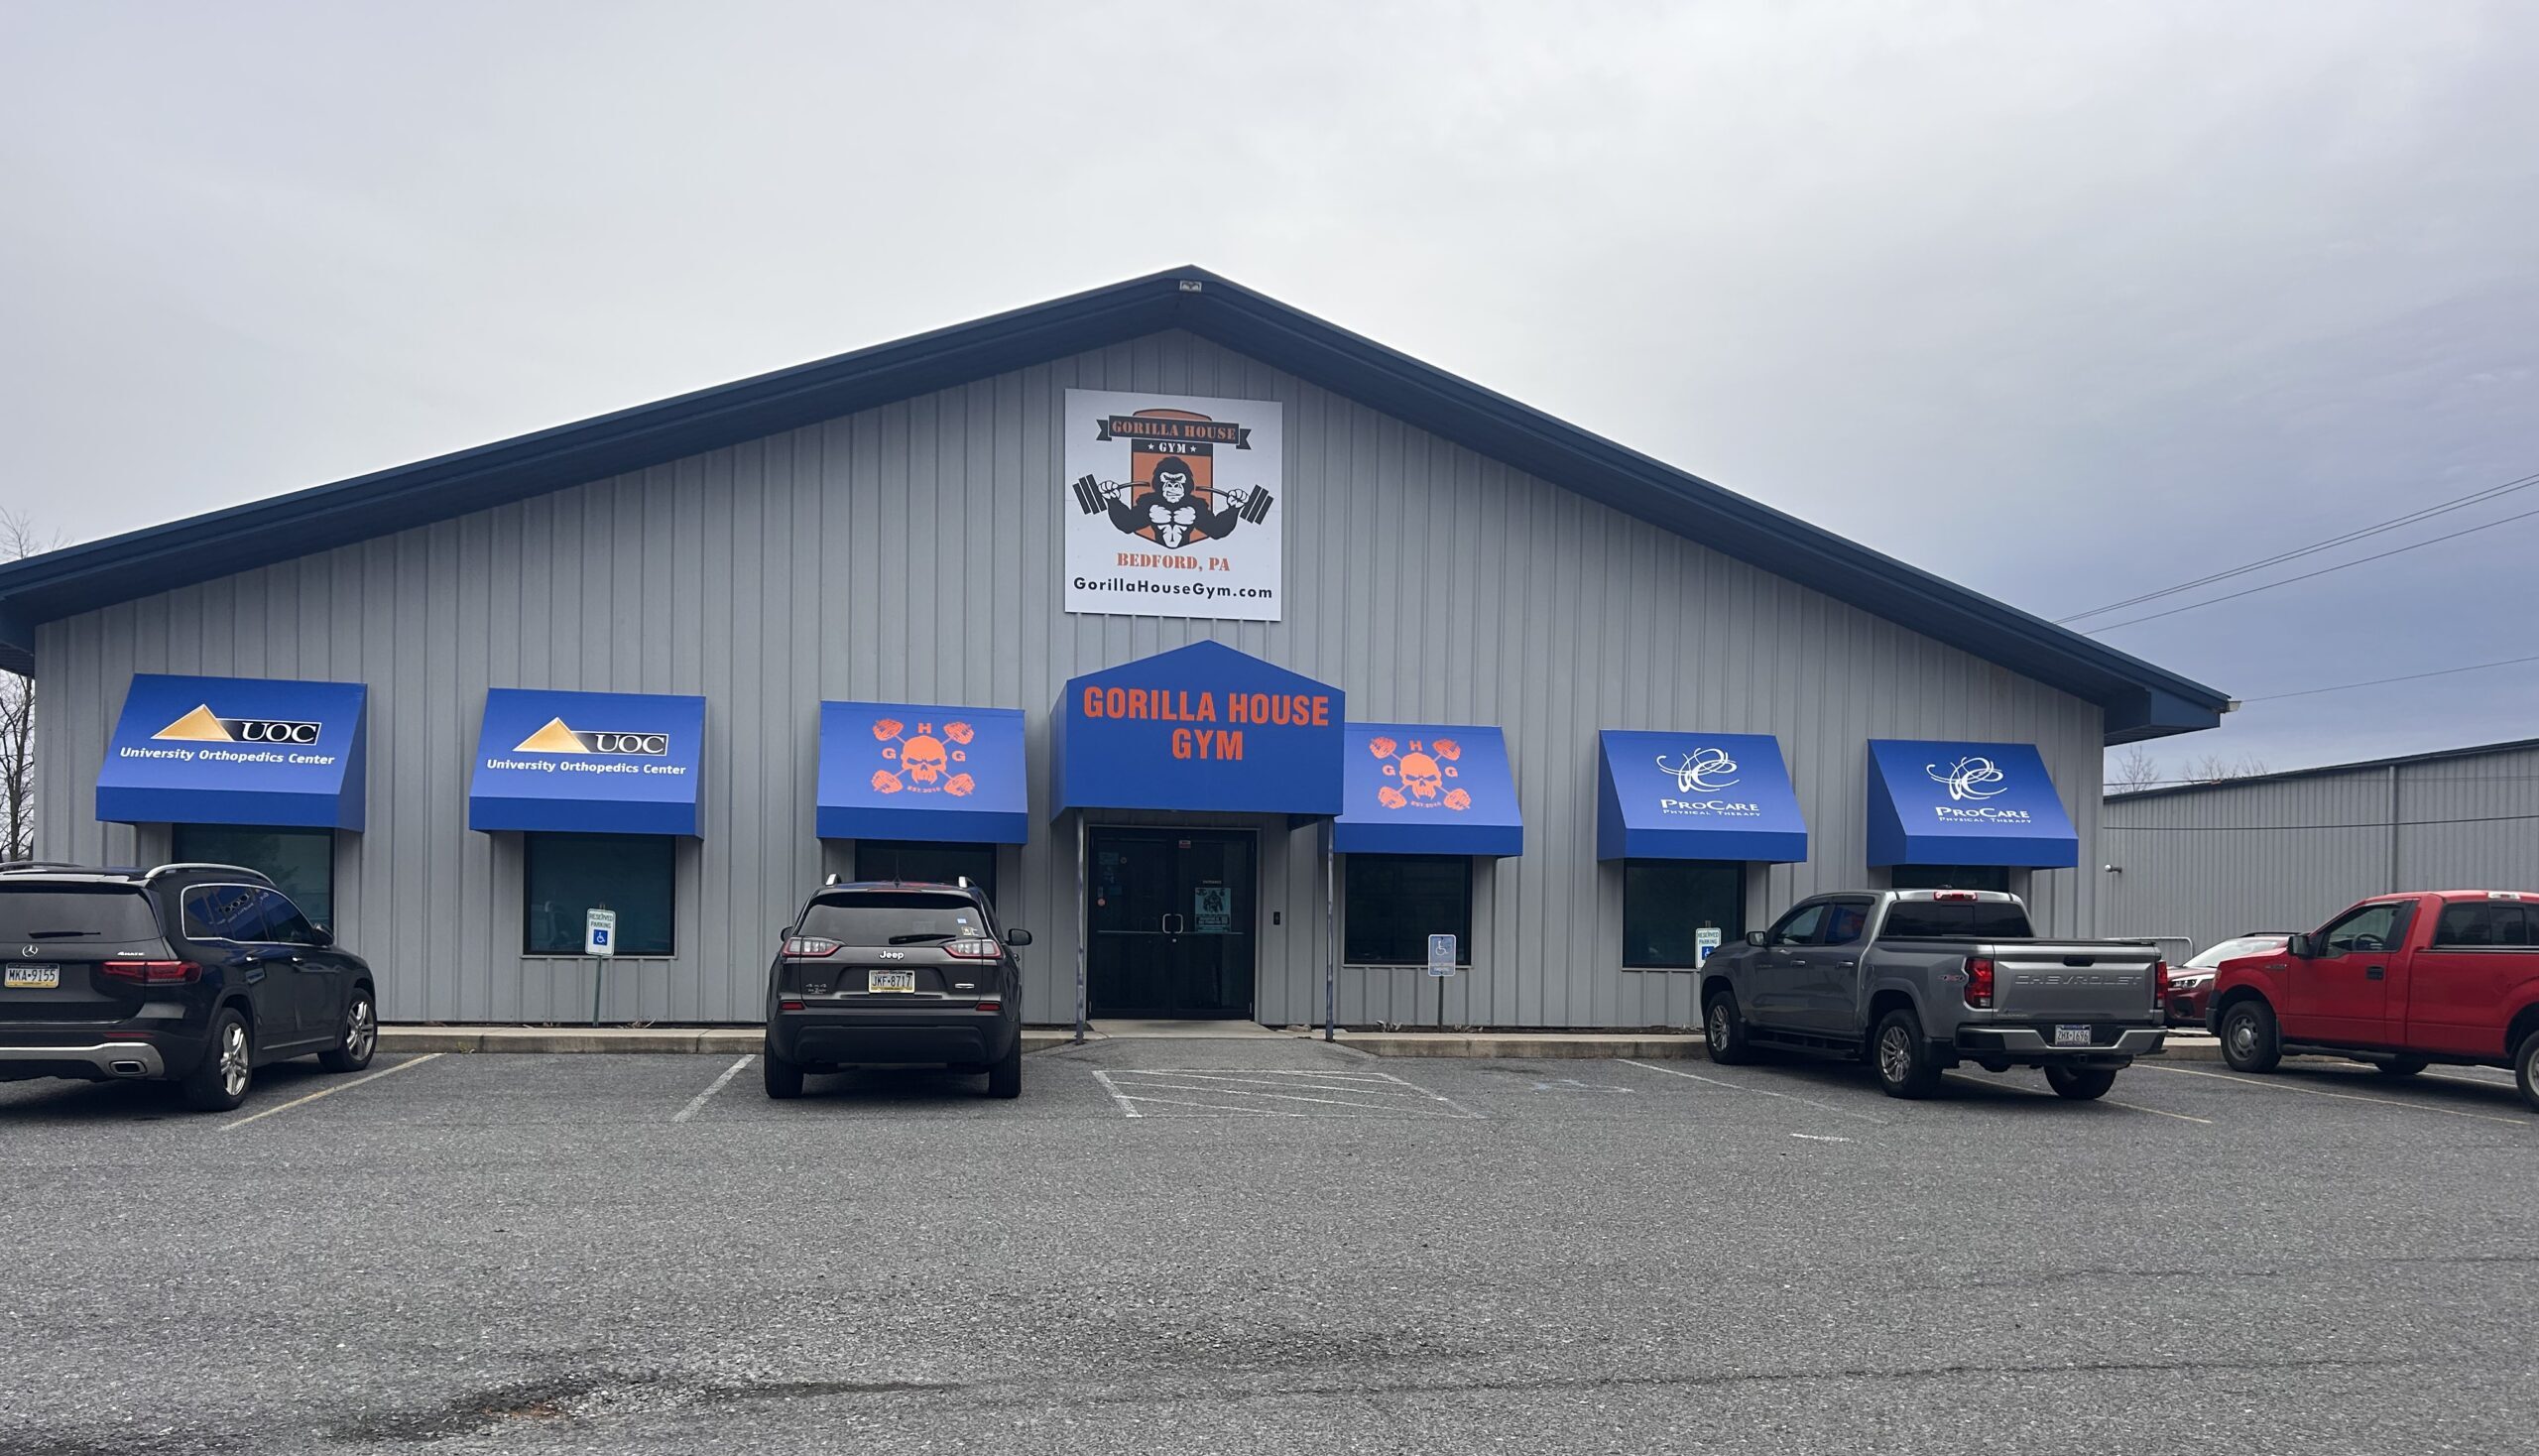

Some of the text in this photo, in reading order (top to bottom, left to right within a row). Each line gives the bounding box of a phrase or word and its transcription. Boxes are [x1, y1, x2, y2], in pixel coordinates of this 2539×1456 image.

[1112, 419, 1237, 440] GORILLA HOUSE
[1158, 442, 1187, 453] GYM
[1117, 552, 1231, 572] BEDFORD, PA
[1073, 576, 1272, 600] GorillaHouseGym.com
[1083, 686, 1329, 726] GORILLA HOUSE
[241, 721, 316, 743] UOC
[917, 722, 932, 734] H
[595, 734, 665, 754] UOC
[1172, 728, 1244, 761] GYM
[1408, 740, 1423, 751] H
[120, 746, 335, 766] University Orthopedics Center
[882, 747, 897, 760] G
[951, 750, 966, 762] G
[486, 759, 686, 775] University Orthopedics Center
[1382, 764, 1396, 776] G
[1444, 766, 1459, 778] G
[879, 950, 905, 960] Jeep
[2014, 974, 2143, 986] CHEVROLET
